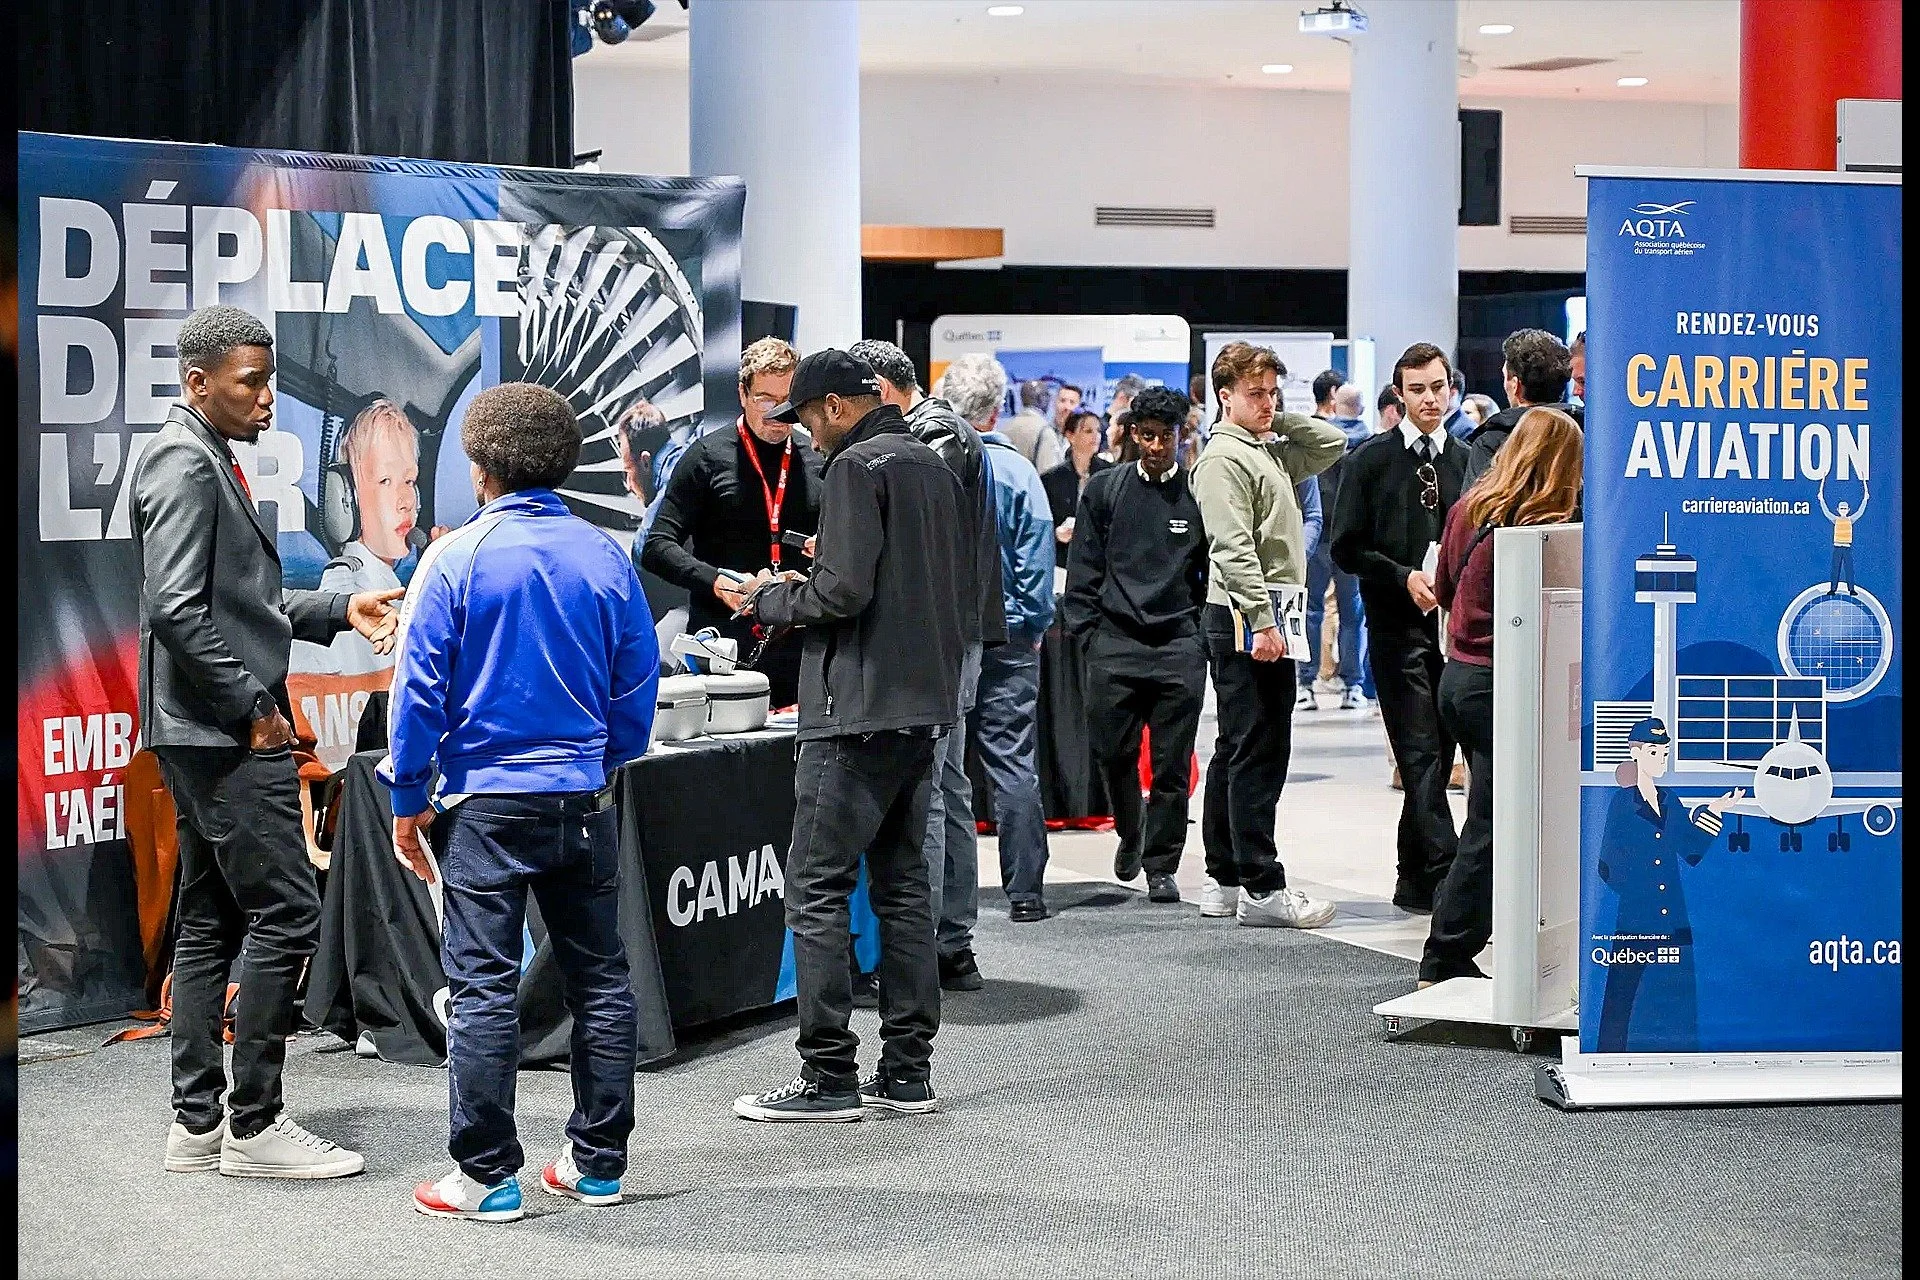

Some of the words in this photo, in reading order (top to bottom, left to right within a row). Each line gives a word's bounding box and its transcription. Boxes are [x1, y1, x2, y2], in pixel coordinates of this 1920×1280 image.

[1618, 219, 1685, 239] AQTA
[38, 180, 524, 317] DÉPLACE
[1634, 241, 1670, 249] Association
[1644, 248, 1673, 256] transport
[1676, 312, 1819, 337] RENDEZ-VOUS
[1624, 421, 1870, 481] AVIATION
[1682, 497, 1810, 515] carriereaviation.ca
[43, 711, 142, 776] EMB
[1591, 947, 1656, 966] Québec
[1809, 934, 1901, 972] aqta.ca
